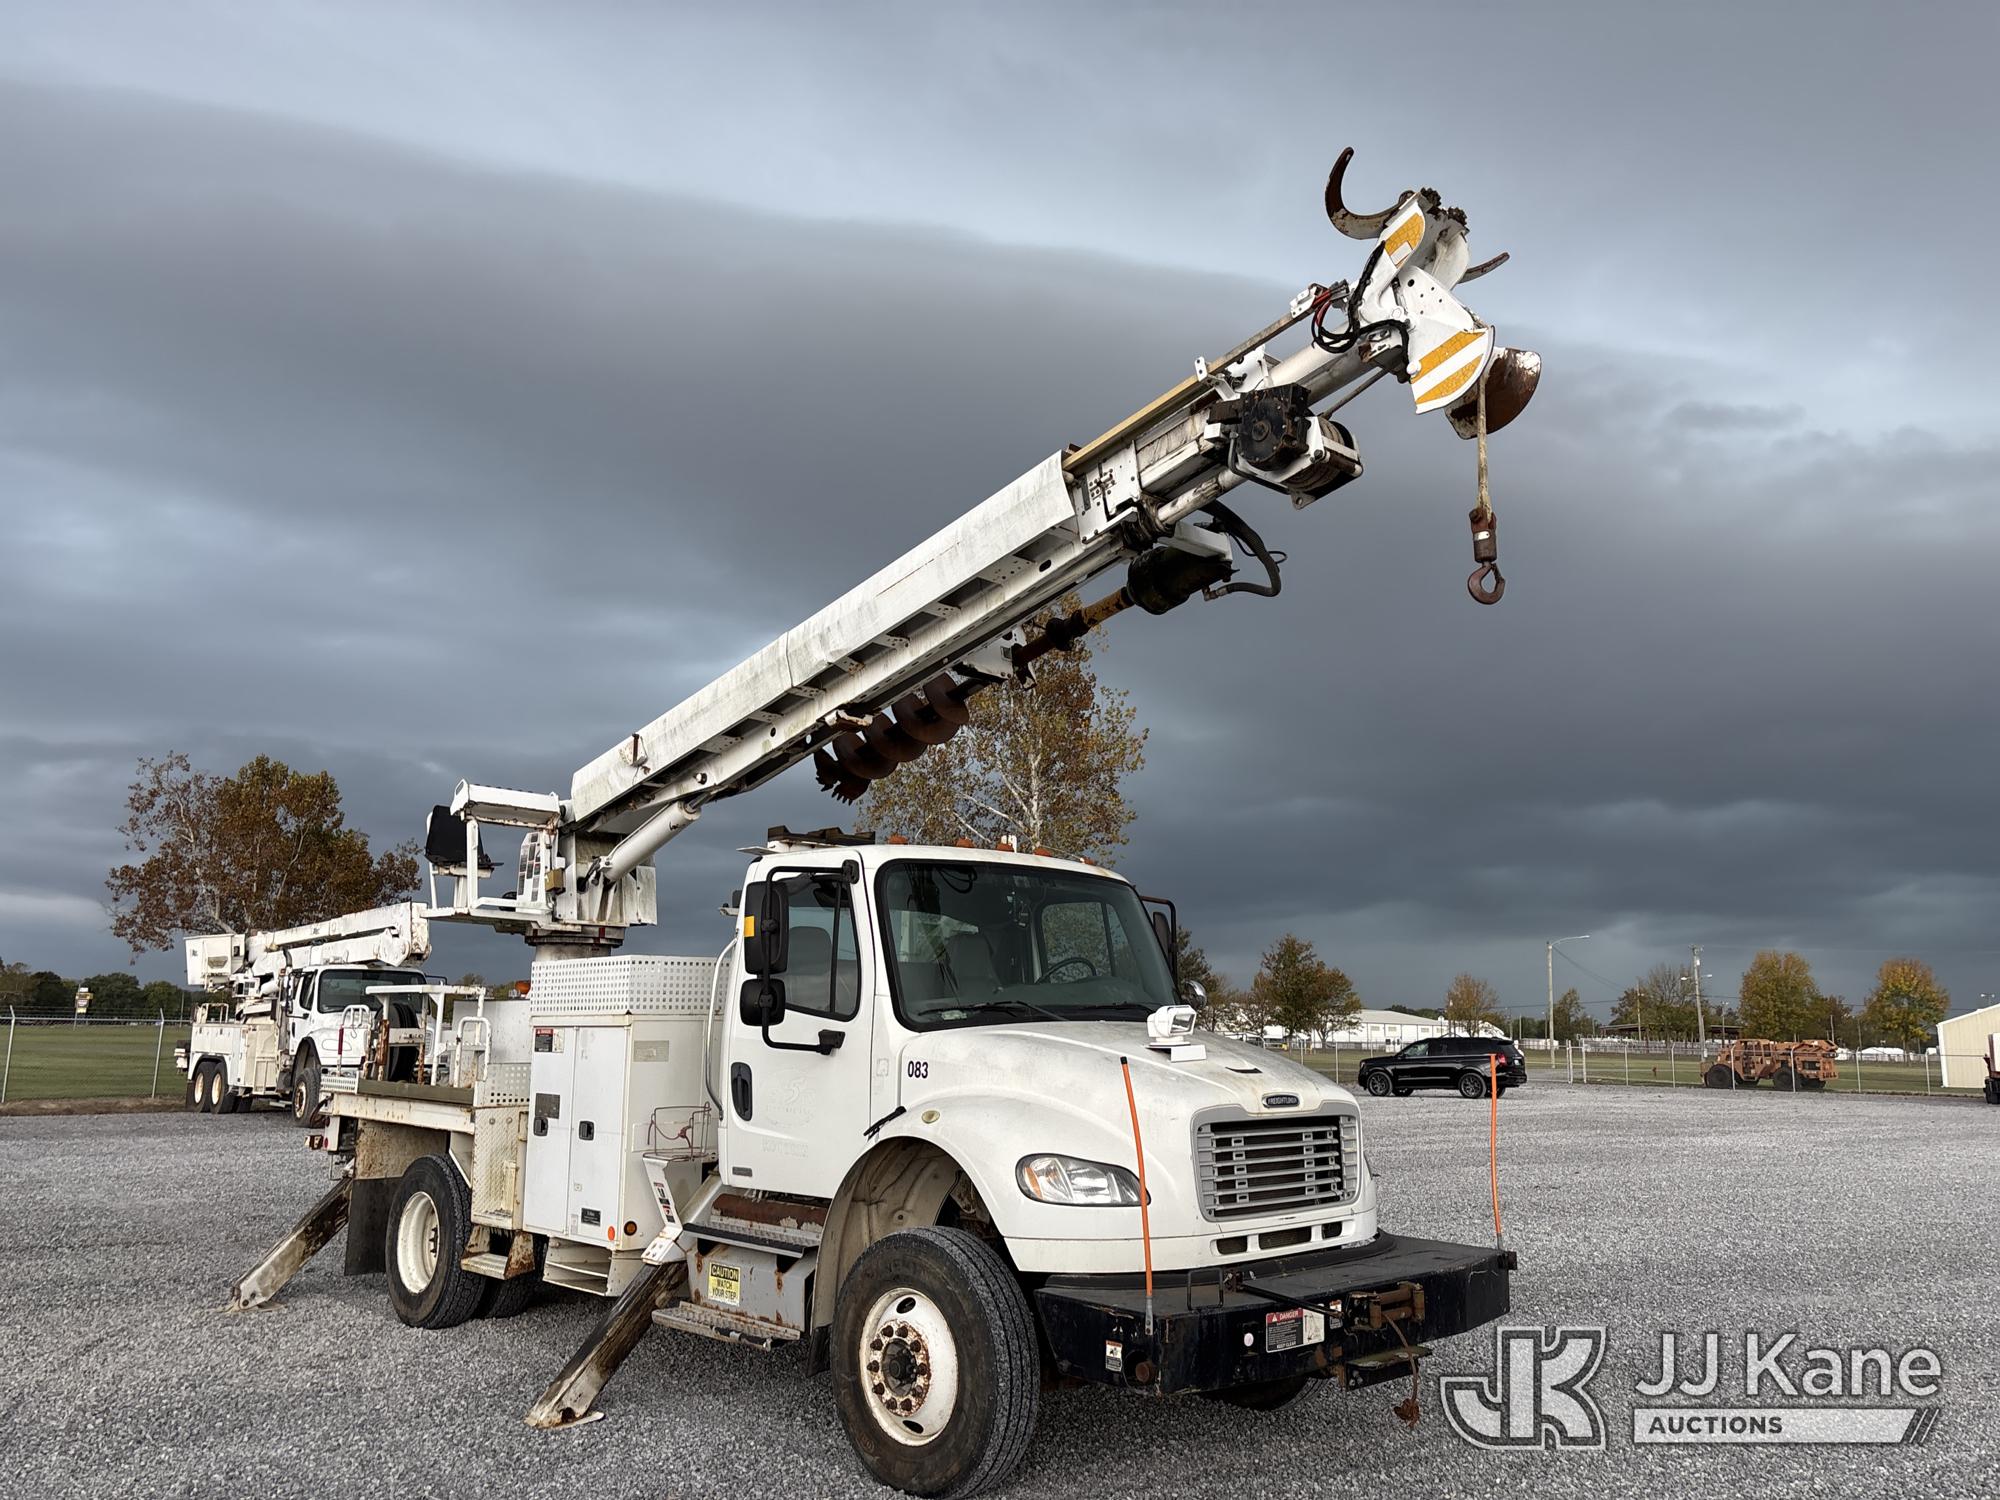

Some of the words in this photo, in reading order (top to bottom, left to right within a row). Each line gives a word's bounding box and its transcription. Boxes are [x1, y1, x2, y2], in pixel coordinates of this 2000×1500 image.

[907, 1060, 929, 1079] 083
[711, 1265, 738, 1281] CAUTION
[716, 1279, 733, 1290] WATCH
[712, 1288, 725, 1298] YOUR
[725, 1289, 737, 1300] STEP
[1279, 1310, 1299, 1321] DANGER
